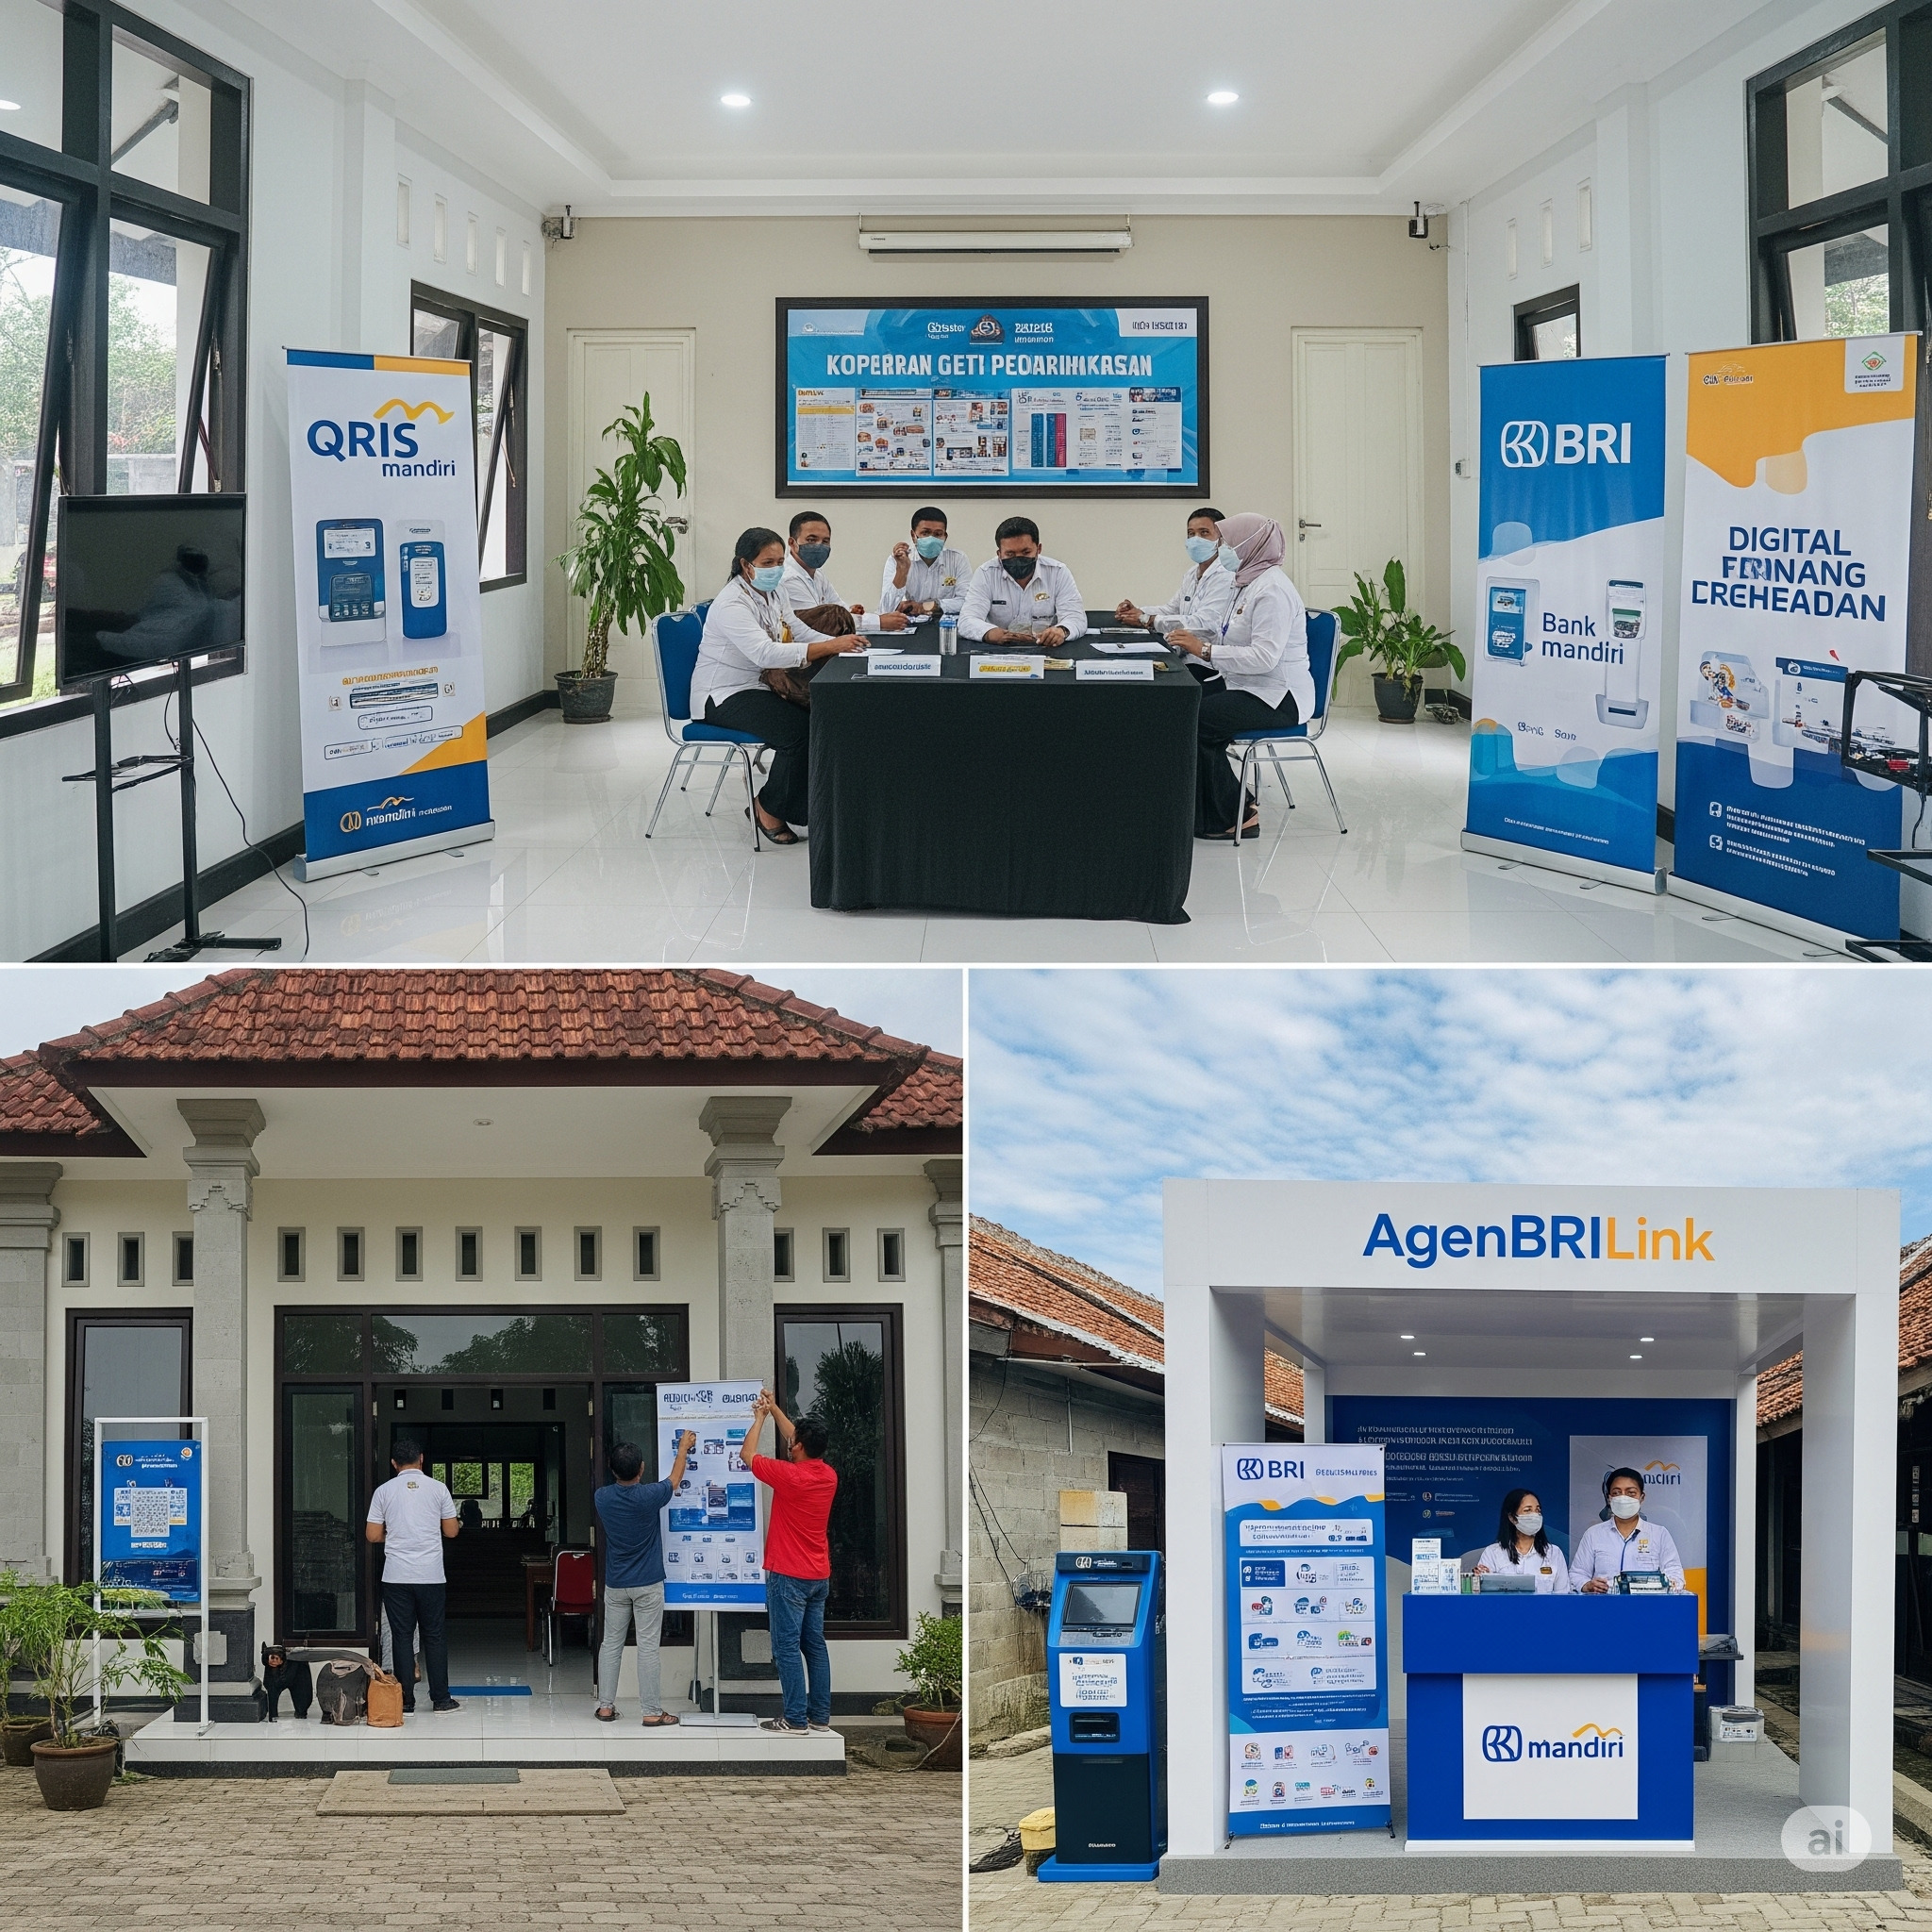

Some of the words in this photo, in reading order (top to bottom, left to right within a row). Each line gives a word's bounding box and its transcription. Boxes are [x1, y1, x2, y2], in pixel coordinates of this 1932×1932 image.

[307, 420, 419, 462] QRIS
[1555, 422, 1632, 464] BRI
[382, 459, 456, 476] mandiri
[1729, 526, 1852, 556] DIGITAL
[1542, 612, 1596, 637] Bank
[1541, 641, 1624, 664] mandiri
[1362, 1213, 1716, 1269] AgenBRILink
[1268, 1460, 1305, 1478] BRI
[1528, 1736, 1624, 1758] mandiri
